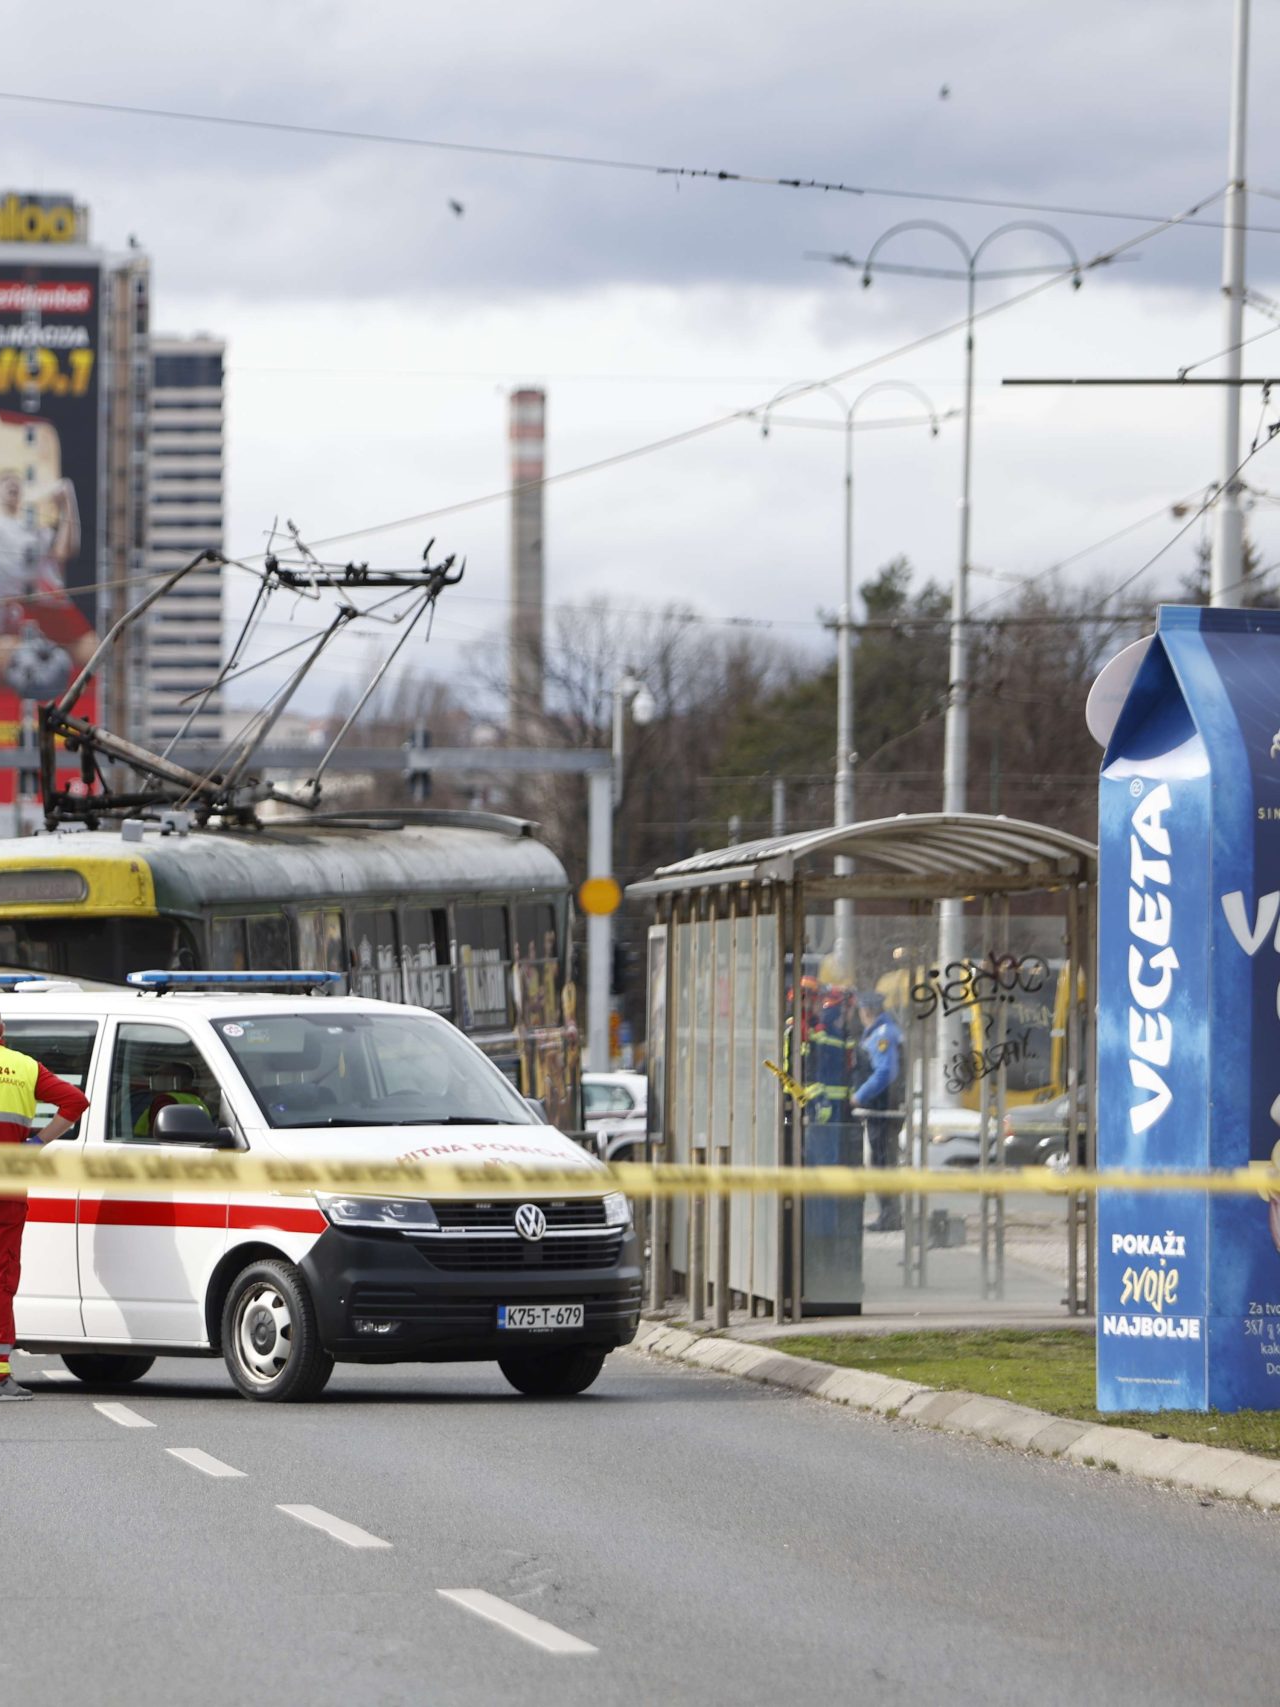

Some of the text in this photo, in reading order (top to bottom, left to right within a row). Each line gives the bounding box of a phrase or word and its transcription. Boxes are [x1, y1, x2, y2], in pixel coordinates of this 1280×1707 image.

[1129, 782, 1179, 1135] VEGETA
[1112, 1230, 1186, 1256] POKAŽI
[1120, 1258, 1179, 1314] svoje
[508, 1307, 581, 1326] K75-T-679
[1103, 1315, 1201, 1340] NAJBOLJE
